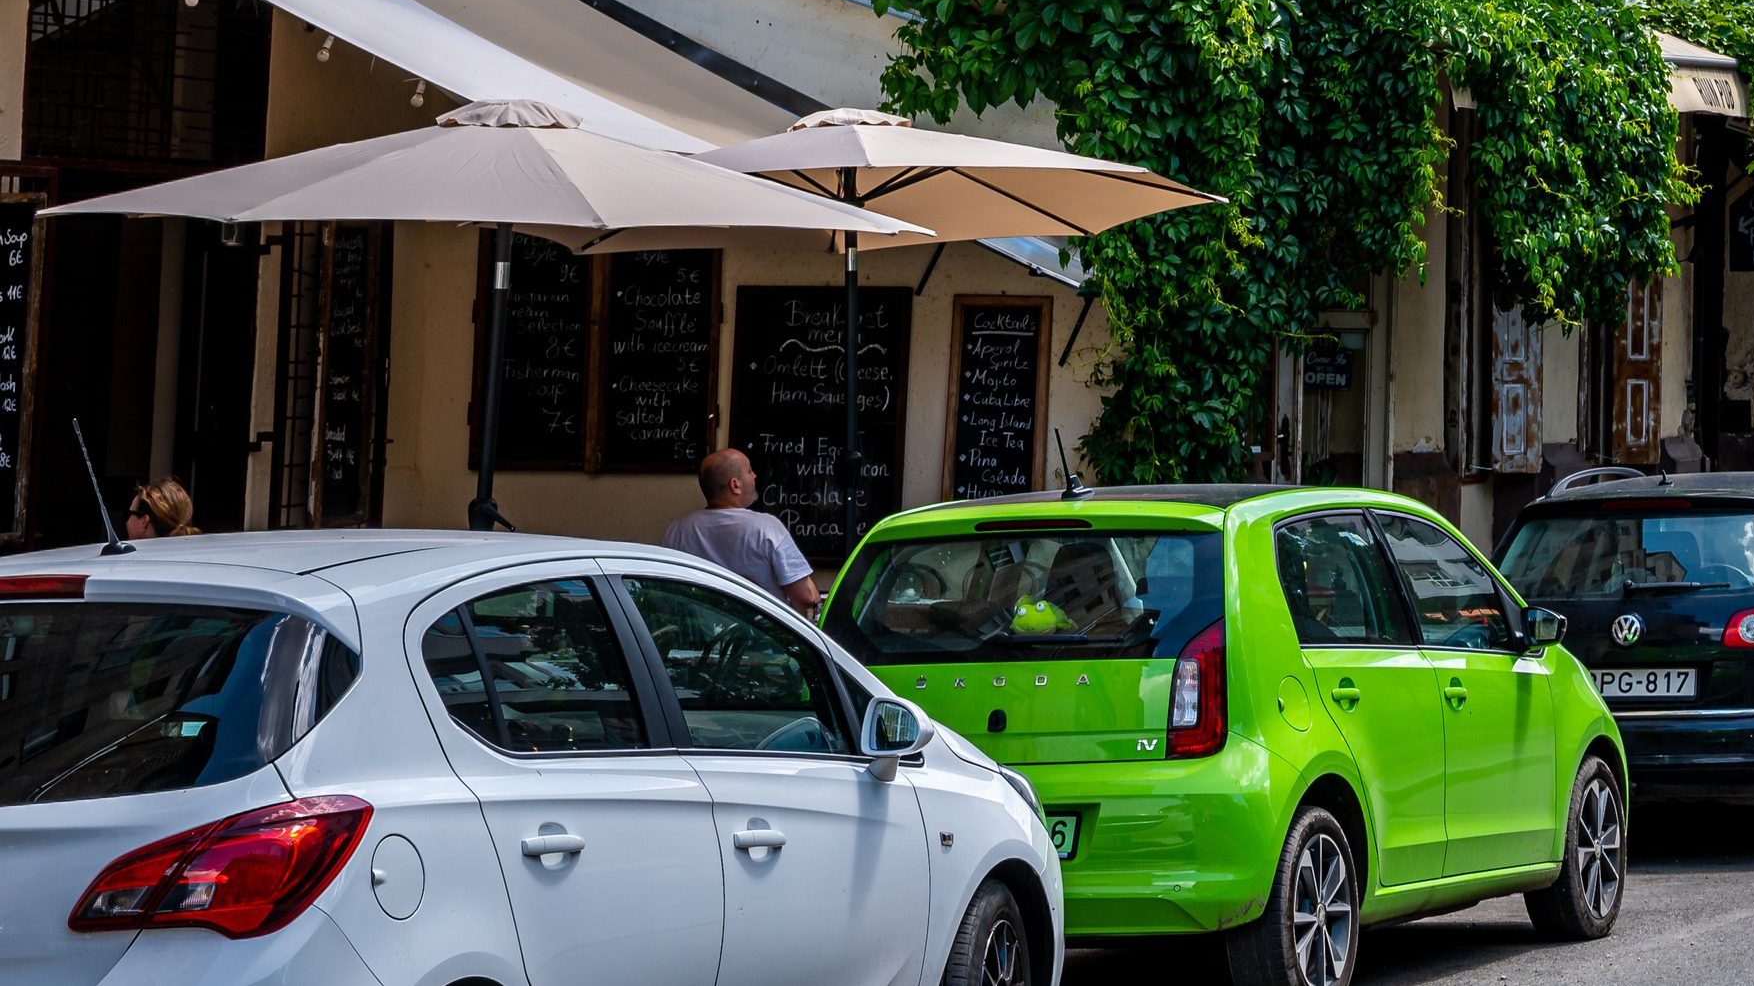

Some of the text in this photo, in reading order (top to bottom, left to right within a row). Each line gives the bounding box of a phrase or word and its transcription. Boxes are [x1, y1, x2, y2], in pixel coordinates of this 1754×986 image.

[1692, 77, 1735, 110] RUIN PUB
[4, 228, 28, 249] Soup
[9, 249, 23, 267] 6€
[559, 264, 582, 282] 9€
[676, 267, 701, 283] 5€
[624, 285, 701, 307] Chocolate
[973, 312, 1036, 331] Cocktails
[613, 333, 645, 355] with
[972, 338, 1020, 359] Aperol
[502, 358, 581, 382] Fisherman
[676, 357, 699, 373] 5€
[619, 375, 699, 393] Cheesecake
[972, 369, 1017, 391] Mojito
[1304, 371, 1347, 386] OPEN
[635, 393, 672, 407] with
[973, 392, 1031, 408] Cuba Libre
[631, 421, 689, 440] caramel
[969, 412, 1032, 432] Long Island
[760, 433, 805, 456] Fried
[979, 430, 1025, 450] Ice Tea
[674, 442, 697, 460] 5€
[968, 447, 998, 467] Pina
[797, 458, 834, 476] with
[763, 481, 868, 507] Chocolae
[778, 509, 867, 537] Pancae
